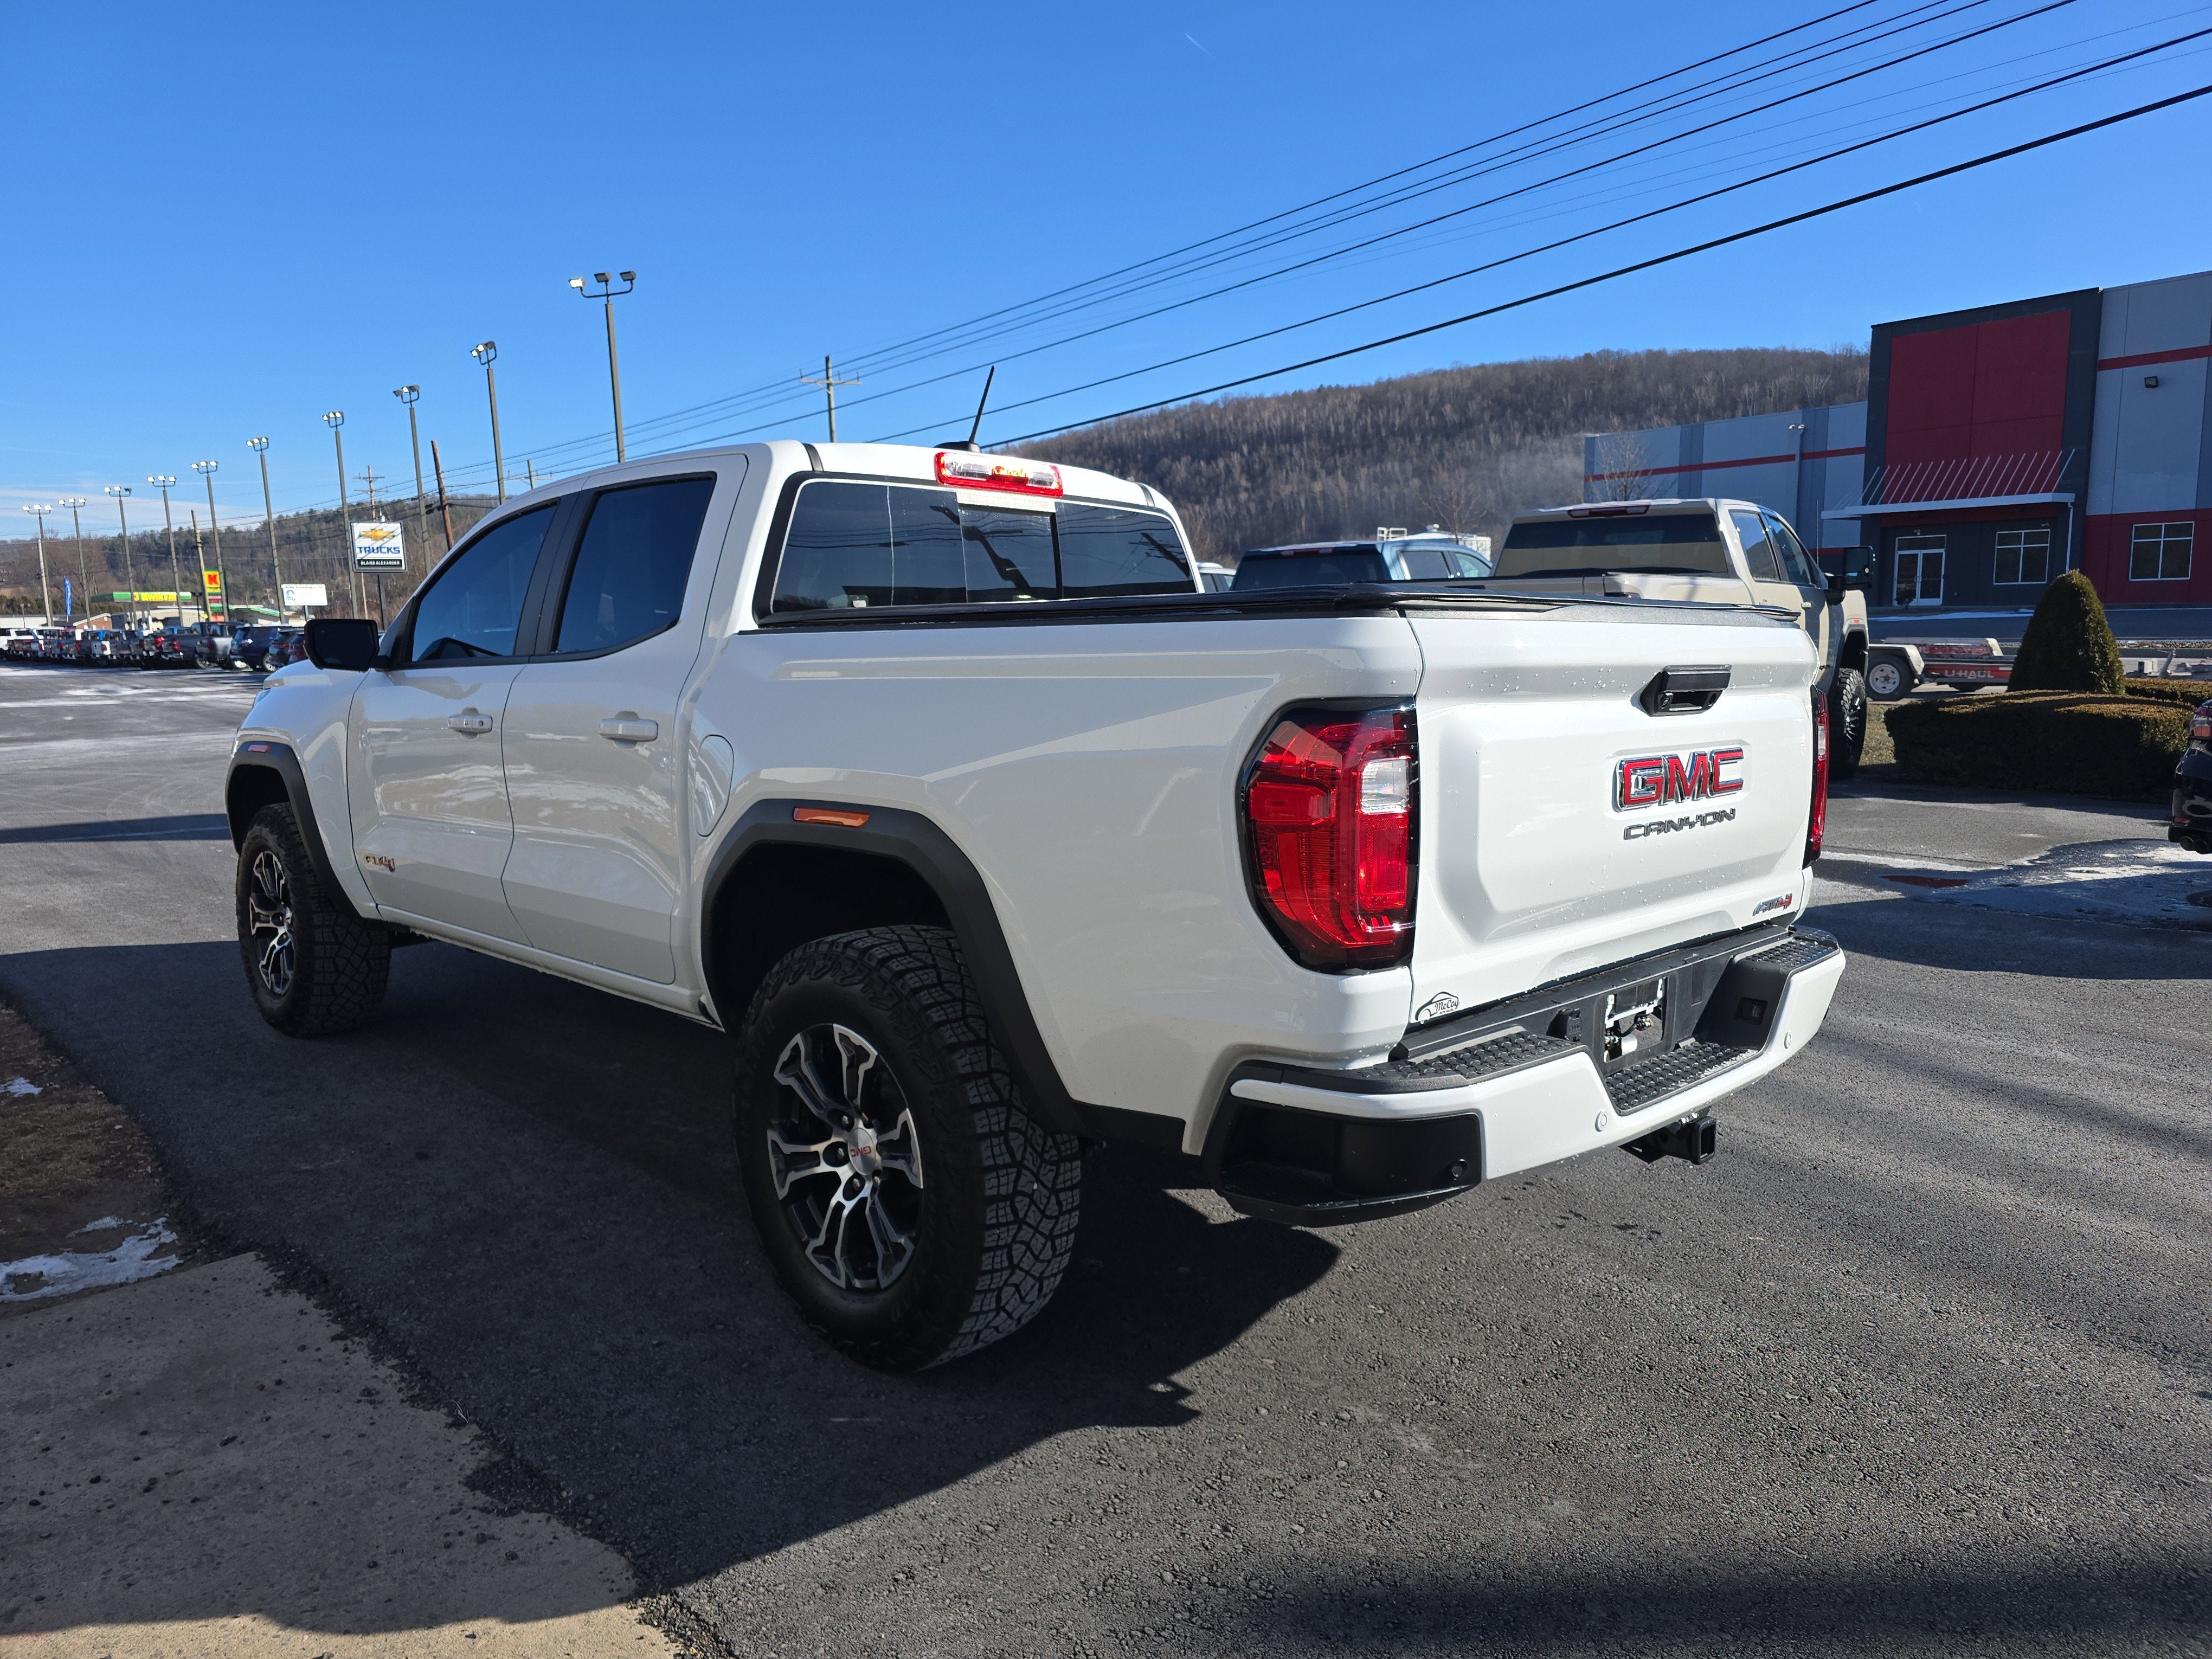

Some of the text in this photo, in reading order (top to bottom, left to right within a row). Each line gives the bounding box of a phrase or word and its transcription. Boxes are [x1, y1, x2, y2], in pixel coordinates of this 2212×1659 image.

[208, 574, 218, 584] K
[1944, 670, 1995, 679] U-HAUL
[1612, 747, 1744, 813] GMC
[1623, 807, 1736, 840] CANYON
[1752, 893, 1793, 917] AT4
[1435, 999, 1458, 1012] McCoy
[850, 1146, 872, 1158] GMC
